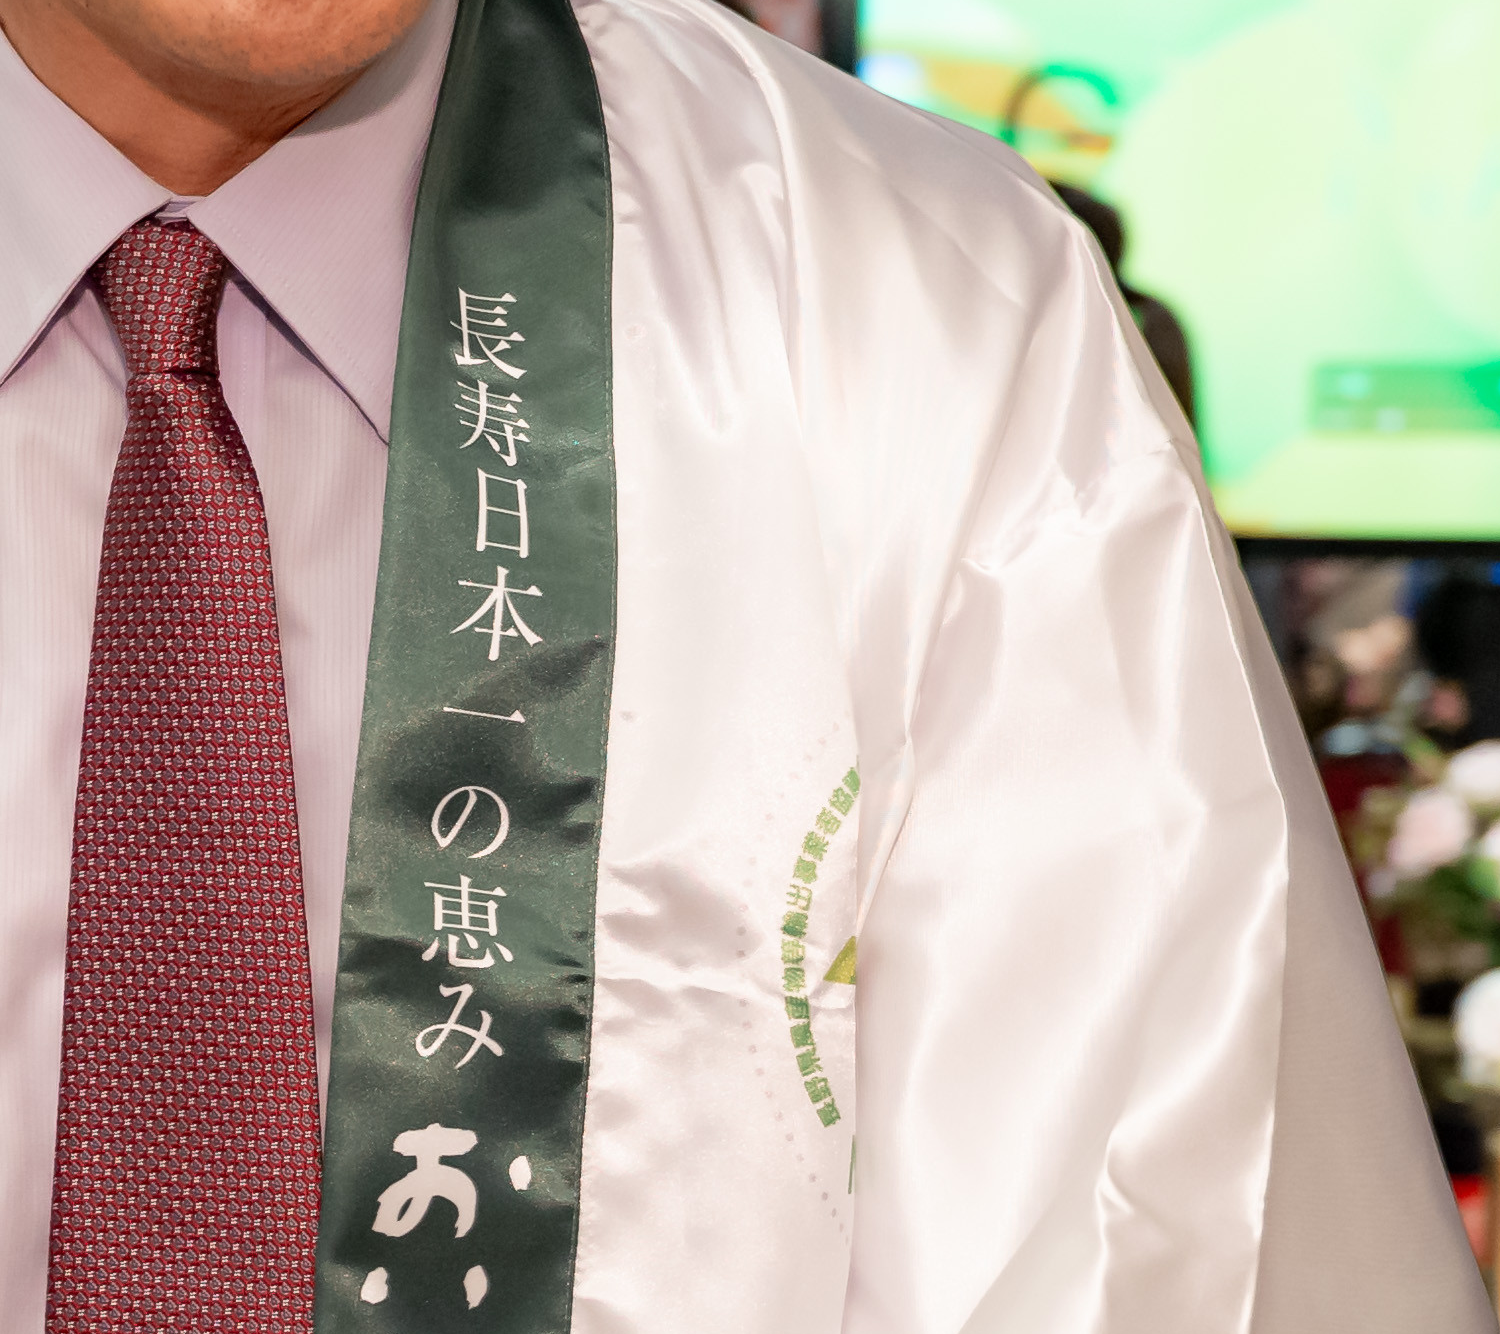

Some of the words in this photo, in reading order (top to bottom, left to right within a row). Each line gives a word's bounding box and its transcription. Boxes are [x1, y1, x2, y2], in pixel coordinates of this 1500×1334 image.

[413, 285, 544, 1072] 長寿日本一の恵み
